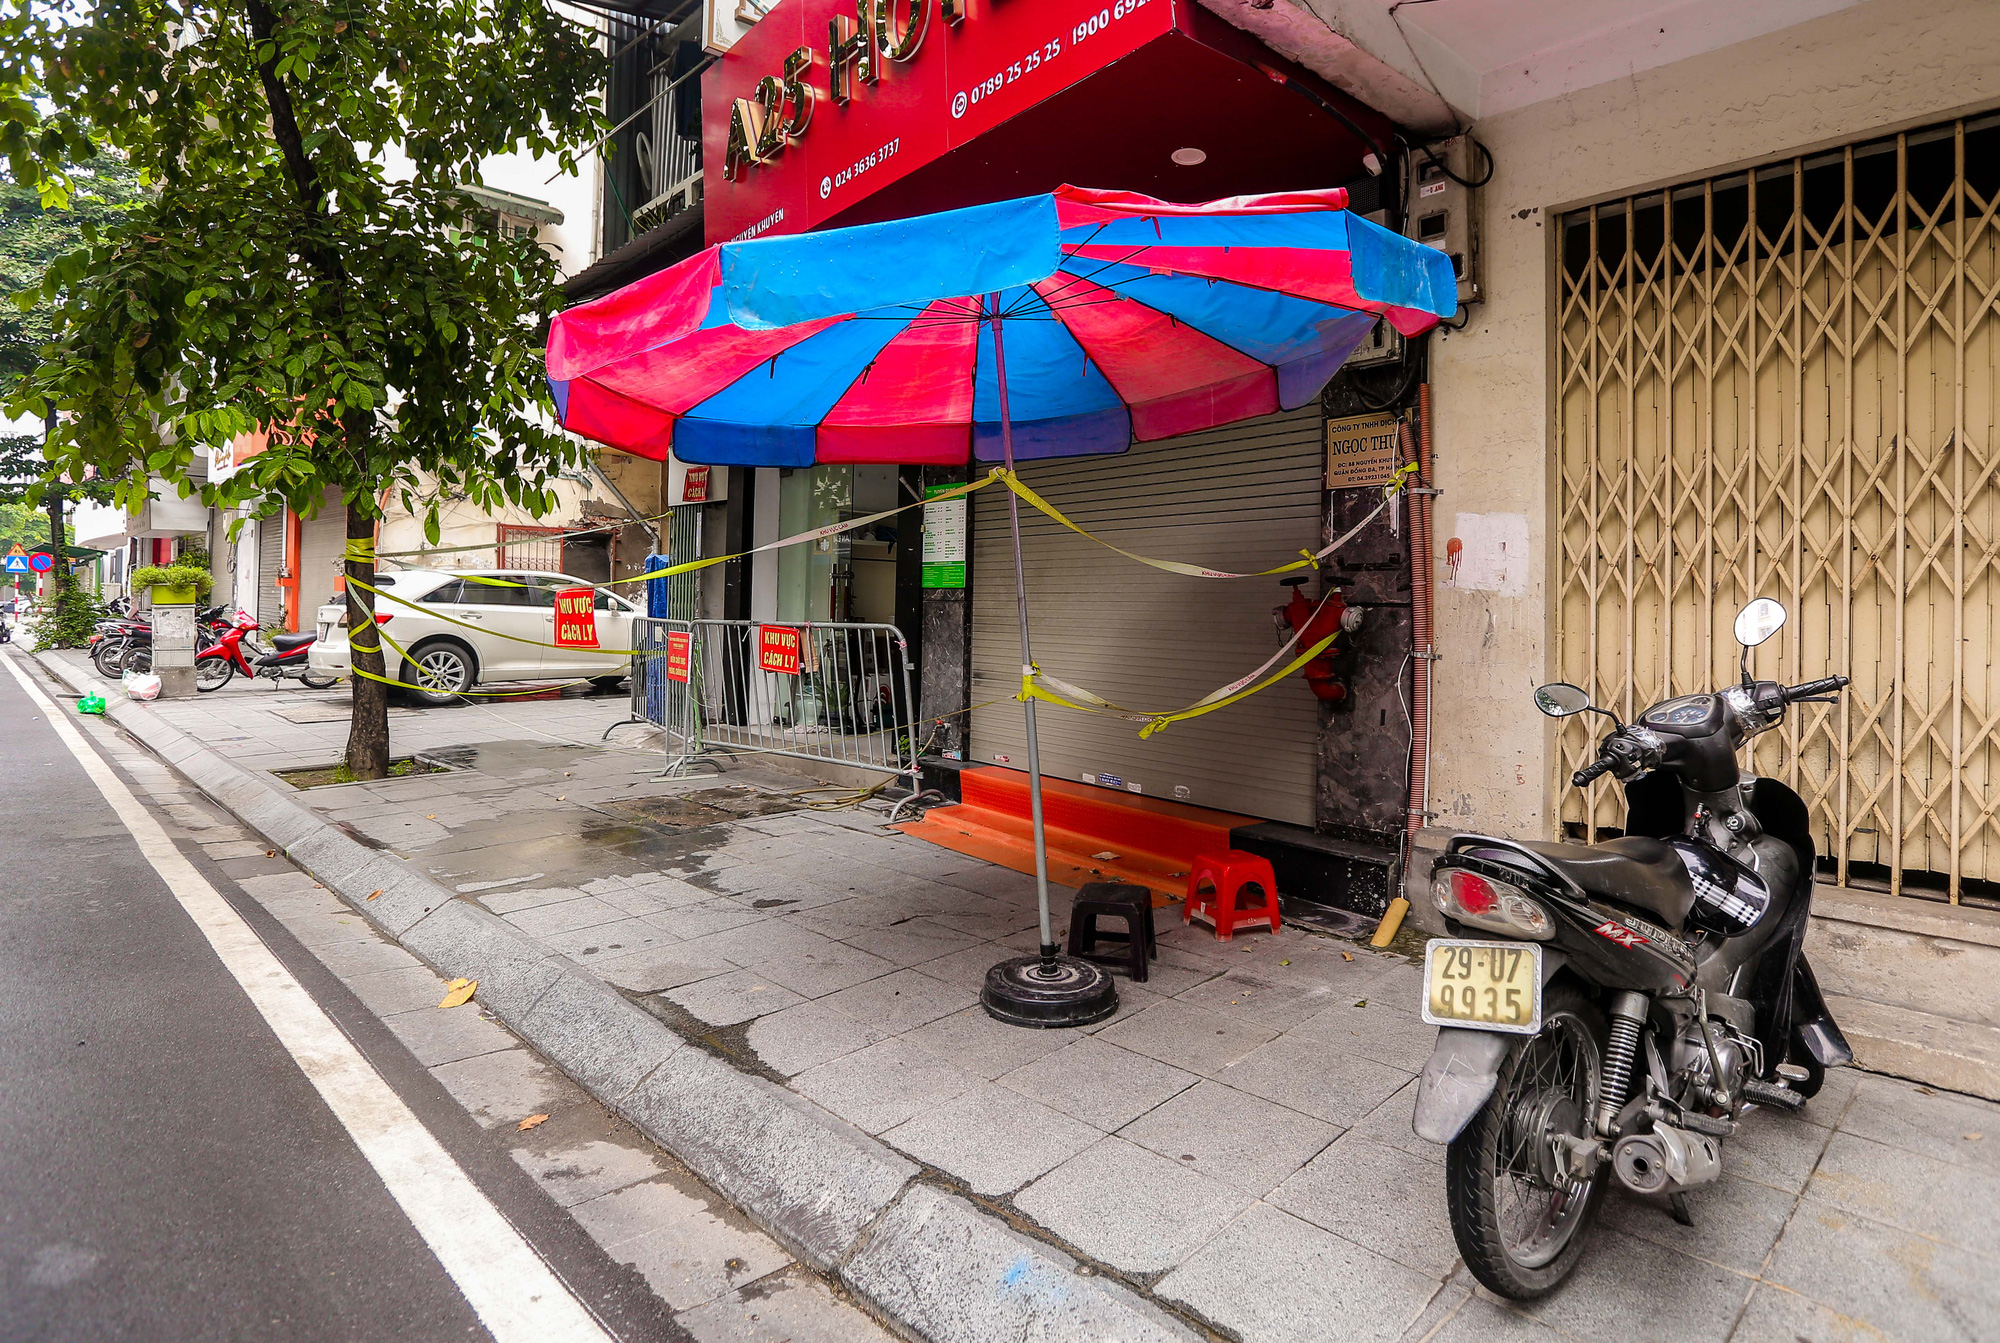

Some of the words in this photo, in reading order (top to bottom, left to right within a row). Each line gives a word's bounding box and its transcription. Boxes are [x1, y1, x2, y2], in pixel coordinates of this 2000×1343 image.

[971, 72, 1003, 104] 0789
[1006, 61, 1022, 84] 25
[1024, 50, 1041, 73] 25
[1044, 38, 1061, 62] 25
[1072, 8, 1110, 45] 1900
[722, 46, 815, 182] A25
[834, 166, 852, 188] 024
[853, 151, 877, 178] 3636
[878, 137, 900, 163] 3737
[1332, 423, 1351, 434] CÔNG
[1353, 423, 1360, 431] TY
[1362, 421, 1379, 429] TNHH
[1332, 437, 1368, 456] NGỌC
[573, 596, 592, 617] VỰC
[561, 620, 581, 641] CÁCH
[582, 624, 593, 641] LY
[764, 631, 779, 645] KHU
[781, 633, 796, 650] VỰC
[764, 650, 783, 667] CÁCH
[784, 655, 795, 668] LY
[1593, 920, 1650, 951] MX
[1442, 947, 1522, 983] 29-U7
[1441, 984, 1521, 1021] 9935
